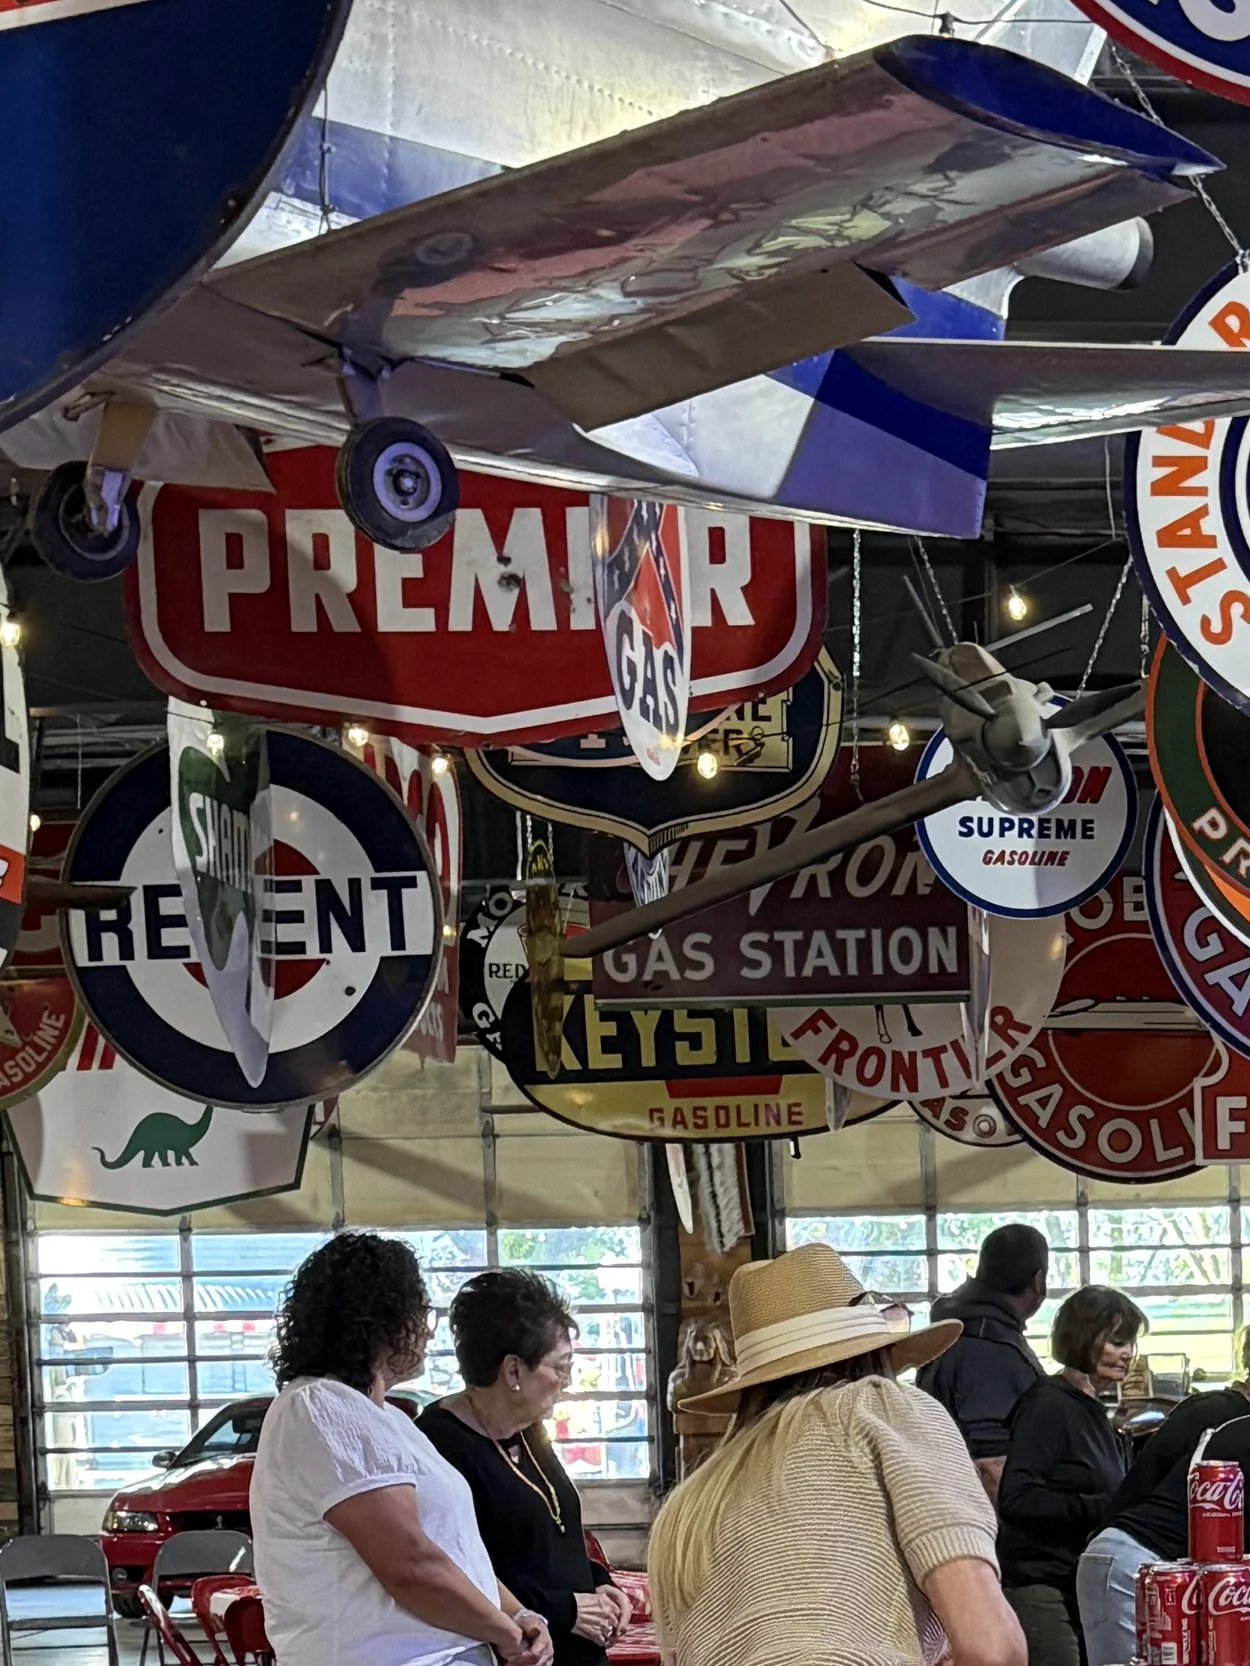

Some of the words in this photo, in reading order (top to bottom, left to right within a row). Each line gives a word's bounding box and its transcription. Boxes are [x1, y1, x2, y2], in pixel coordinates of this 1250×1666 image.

[200, 506, 756, 634] PREMIR
[615, 608, 680, 737] GAS
[957, 815, 1096, 841] SUPREME
[981, 849, 1071, 868] GASOLINE
[85, 875, 419, 963] REENT
[602, 932, 715, 984] GAS
[739, 925, 959, 981] STATION
[0, 1009, 66, 1087] ASOLINE
[791, 1004, 1033, 1094] FRONTIR
[648, 1101, 805, 1131] GASOLINE
[1001, 1046, 1198, 1165] GASOLI
